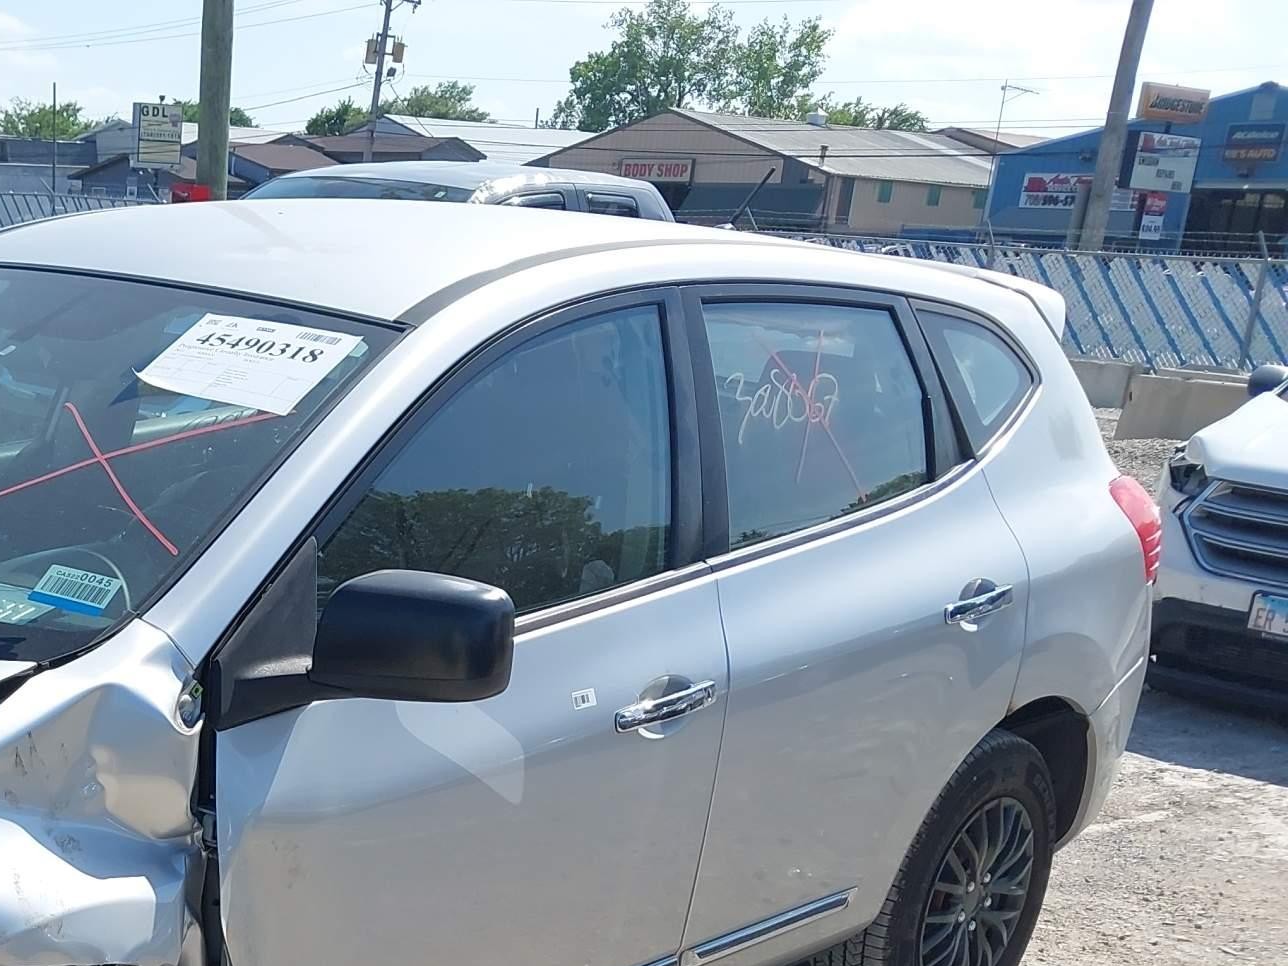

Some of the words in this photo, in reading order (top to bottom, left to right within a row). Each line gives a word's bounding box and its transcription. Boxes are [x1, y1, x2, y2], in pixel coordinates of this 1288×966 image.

[141, 105, 169, 118] GDL
[624, 163, 654, 177] BODY
[656, 163, 689, 178] SHOP
[196, 331, 325, 364] 45490318
